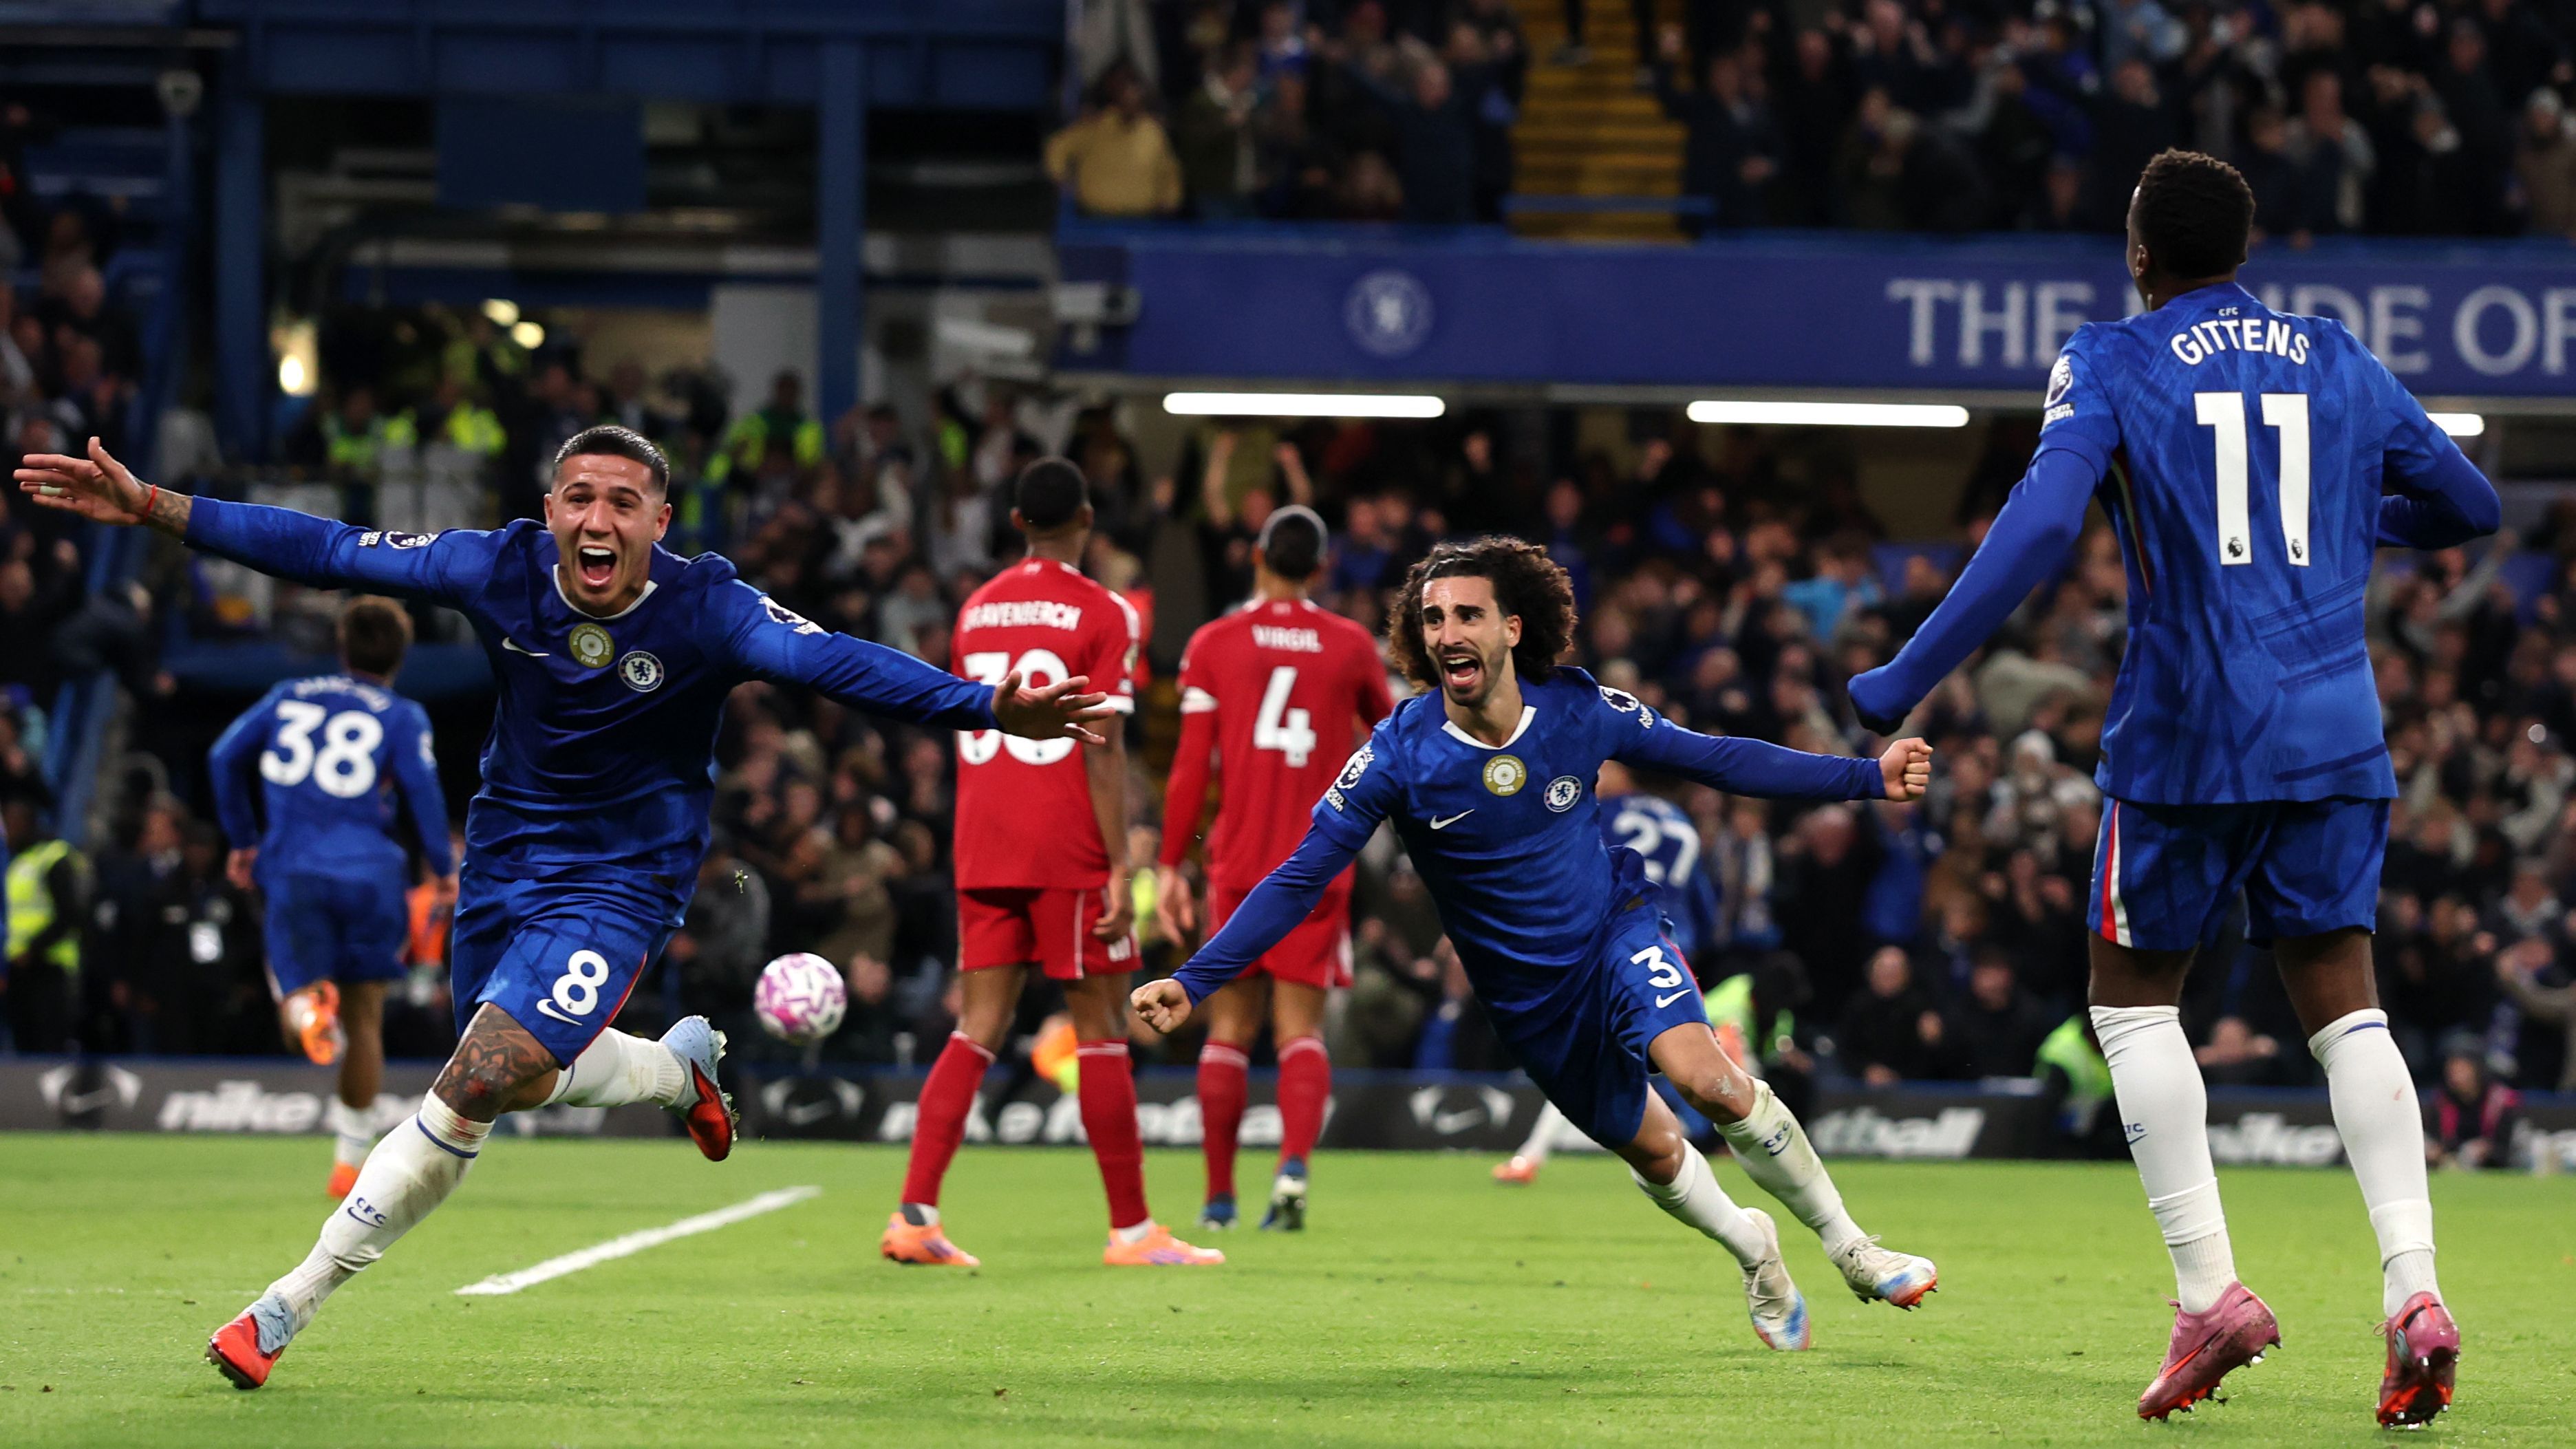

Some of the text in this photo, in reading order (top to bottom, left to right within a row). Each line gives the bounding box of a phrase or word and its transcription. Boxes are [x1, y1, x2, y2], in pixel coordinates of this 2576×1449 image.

[1887, 280, 2096, 368] THE
[2218, 307, 2239, 317] CFC
[2171, 319, 2310, 365] GITTENS
[2193, 391, 2311, 567] 11
[580, 654, 599, 665] FIFA
[1252, 623, 1324, 653] VIRGIL
[1253, 665, 1318, 769] 4
[259, 698, 384, 799] 38
[1612, 811, 1702, 889] 27
[552, 949, 610, 1015] 8
[1629, 945, 1683, 988] 3
[1763, 1119, 1791, 1148] CFC
[356, 1196, 387, 1225] CFC
